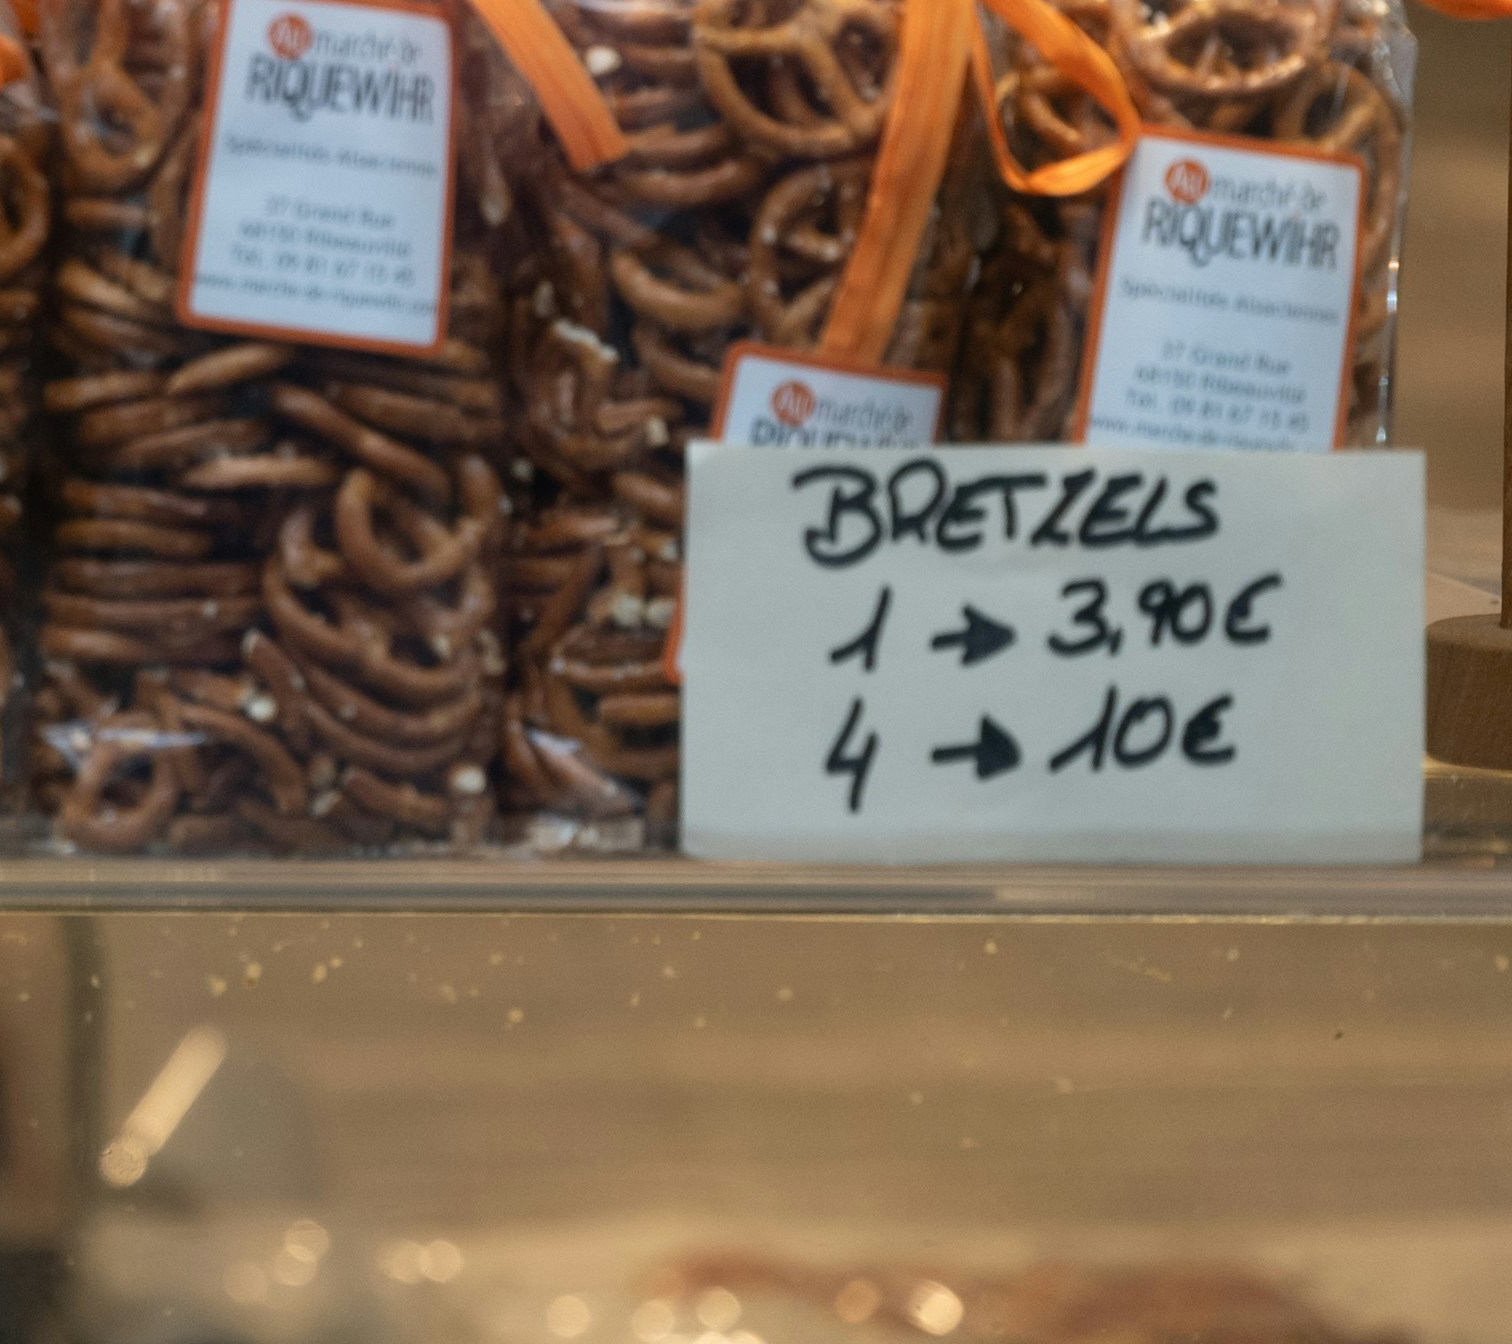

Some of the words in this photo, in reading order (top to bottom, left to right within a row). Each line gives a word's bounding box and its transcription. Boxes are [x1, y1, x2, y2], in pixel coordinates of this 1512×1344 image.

[245, 51, 436, 126] RIQUEWIHR
[1139, 197, 1342, 272] RIQUEWIHR
[790, 456, 1222, 572] BRETZELS
[828, 584, 894, 674] 1
[1045, 572, 1284, 659] 3,90€
[824, 697, 881, 814] 4
[1047, 684, 1238, 775] 10€
